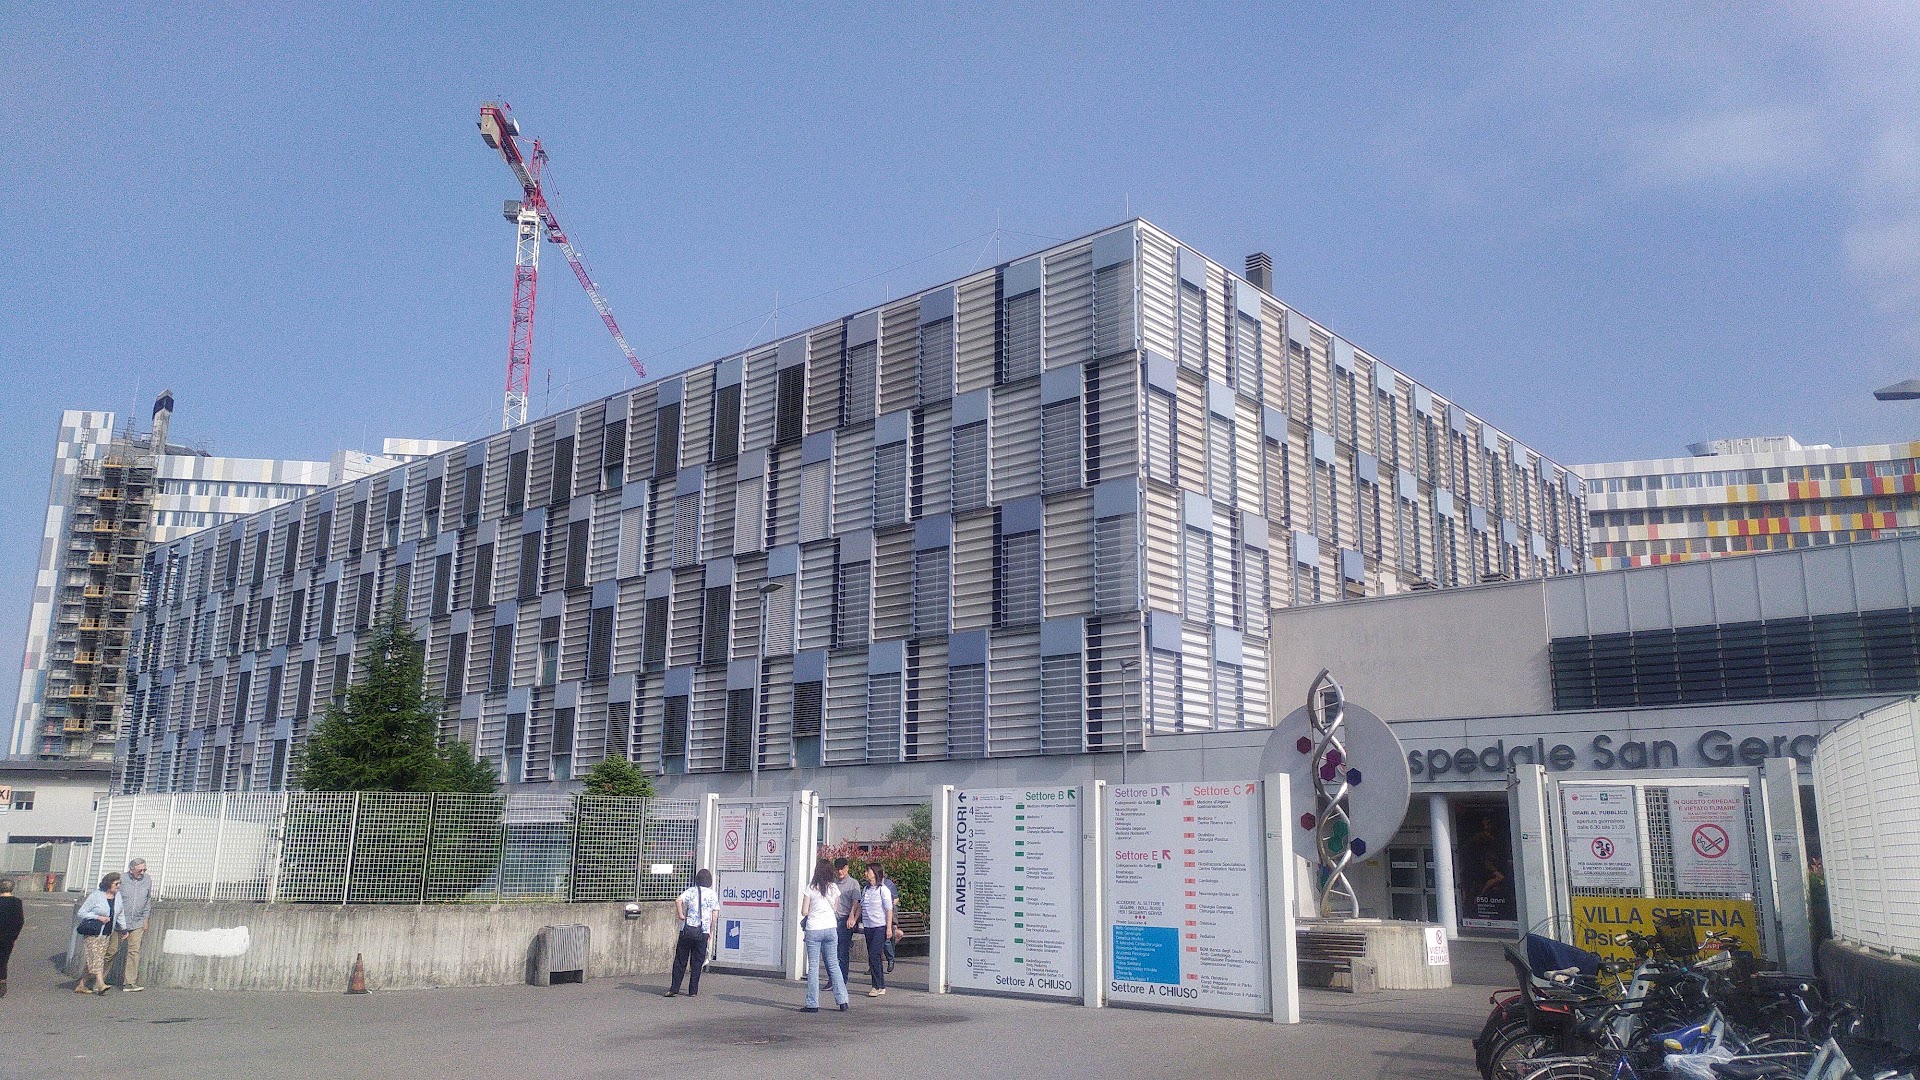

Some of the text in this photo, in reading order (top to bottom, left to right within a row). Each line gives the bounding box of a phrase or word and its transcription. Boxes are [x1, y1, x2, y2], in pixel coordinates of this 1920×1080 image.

[1410, 730, 1821, 780] spedale San Gera
[1115, 787, 1158, 798] Settore D
[1193, 785, 1241, 796] Settore C
[1025, 791, 1056, 801] Settore
[1058, 791, 1064, 800] B
[969, 806, 974, 815] 4
[969, 829, 974, 838] 3
[968, 841, 973, 850] 2
[1115, 850, 1158, 860] Settore E
[956, 806, 967, 915] AMBULATORI
[968, 881, 972, 890] 1
[723, 886, 737, 900] dai,
[1582, 906, 1644, 925] VILLA
[967, 936, 972, 946] T
[967, 957, 973, 967] S
[995, 975, 1072, 990] Settore A CHIUSO
[1111, 982, 1198, 999] Settore A CHIUSO
